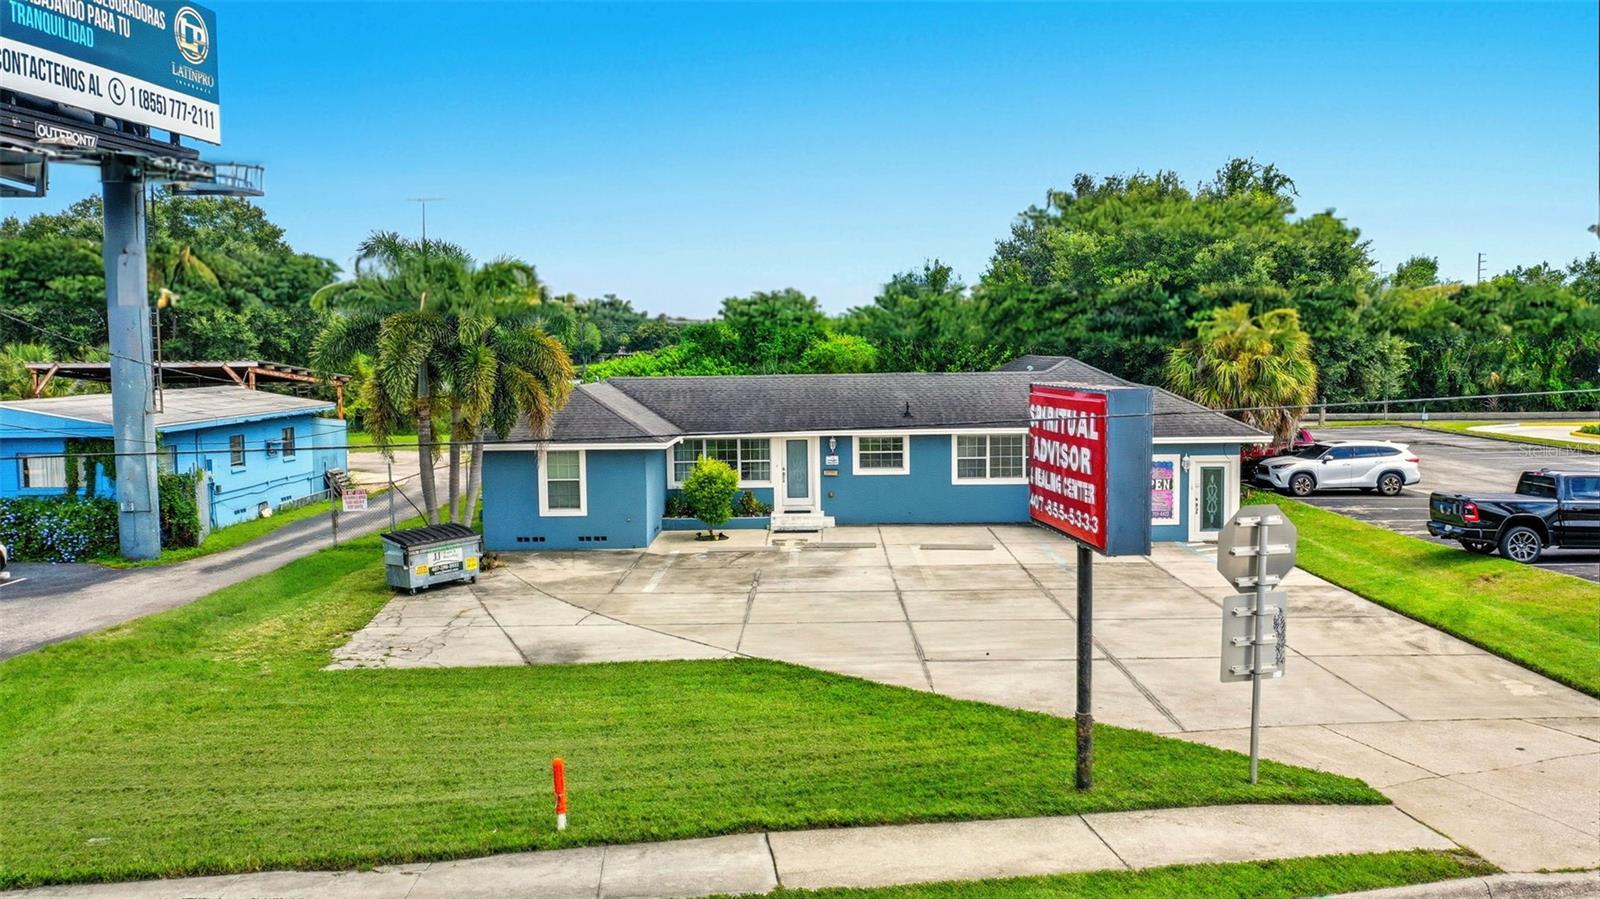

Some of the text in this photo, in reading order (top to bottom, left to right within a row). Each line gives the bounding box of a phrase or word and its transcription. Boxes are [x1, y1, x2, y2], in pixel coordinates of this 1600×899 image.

[9, 0, 94, 48] TRANQUILIDAD
[87, 3, 116, 33] PARA
[117, 14, 131, 38] TU
[0, 48, 215, 130] ONTACTENOS AL 1 (855) 777-2111
[1030, 404, 1099, 441] SPIRITUAL
[1033, 437, 1092, 475] ADVISOR
[1063, 477, 1096, 505] CENTER
